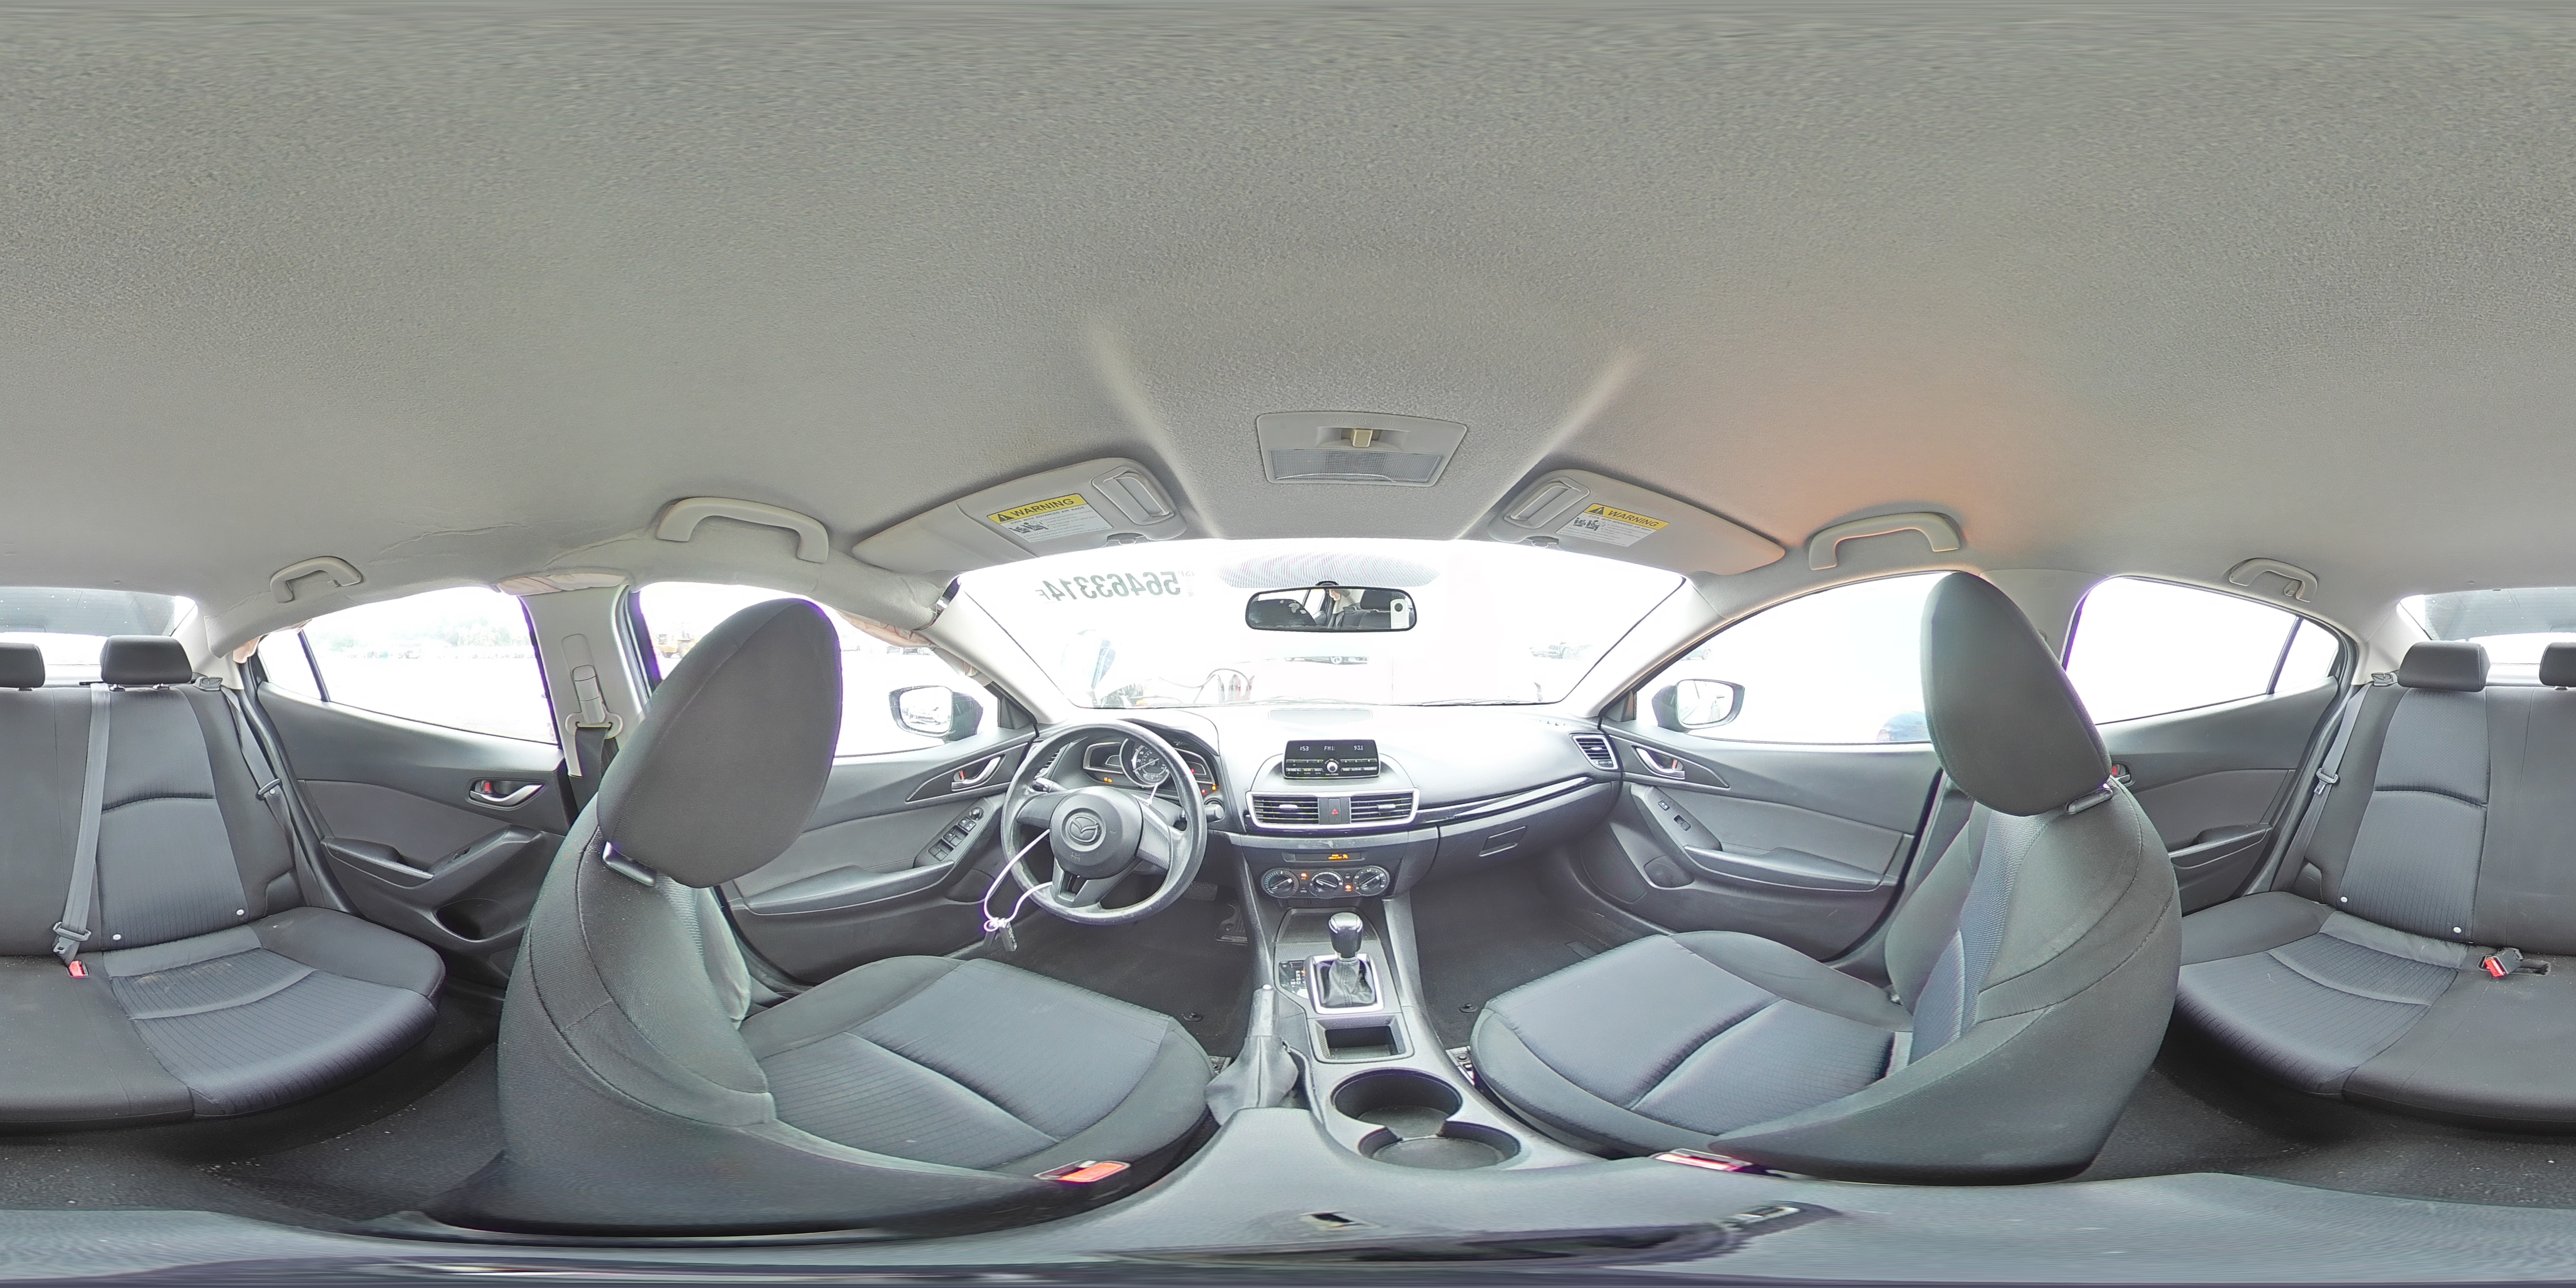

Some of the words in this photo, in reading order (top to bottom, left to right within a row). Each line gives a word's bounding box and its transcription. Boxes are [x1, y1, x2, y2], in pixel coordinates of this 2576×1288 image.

[1010, 498, 1074, 517] WARNING
[1035, 511, 1060, 519] ADVANCED
[1608, 510, 1659, 527] WARNING
